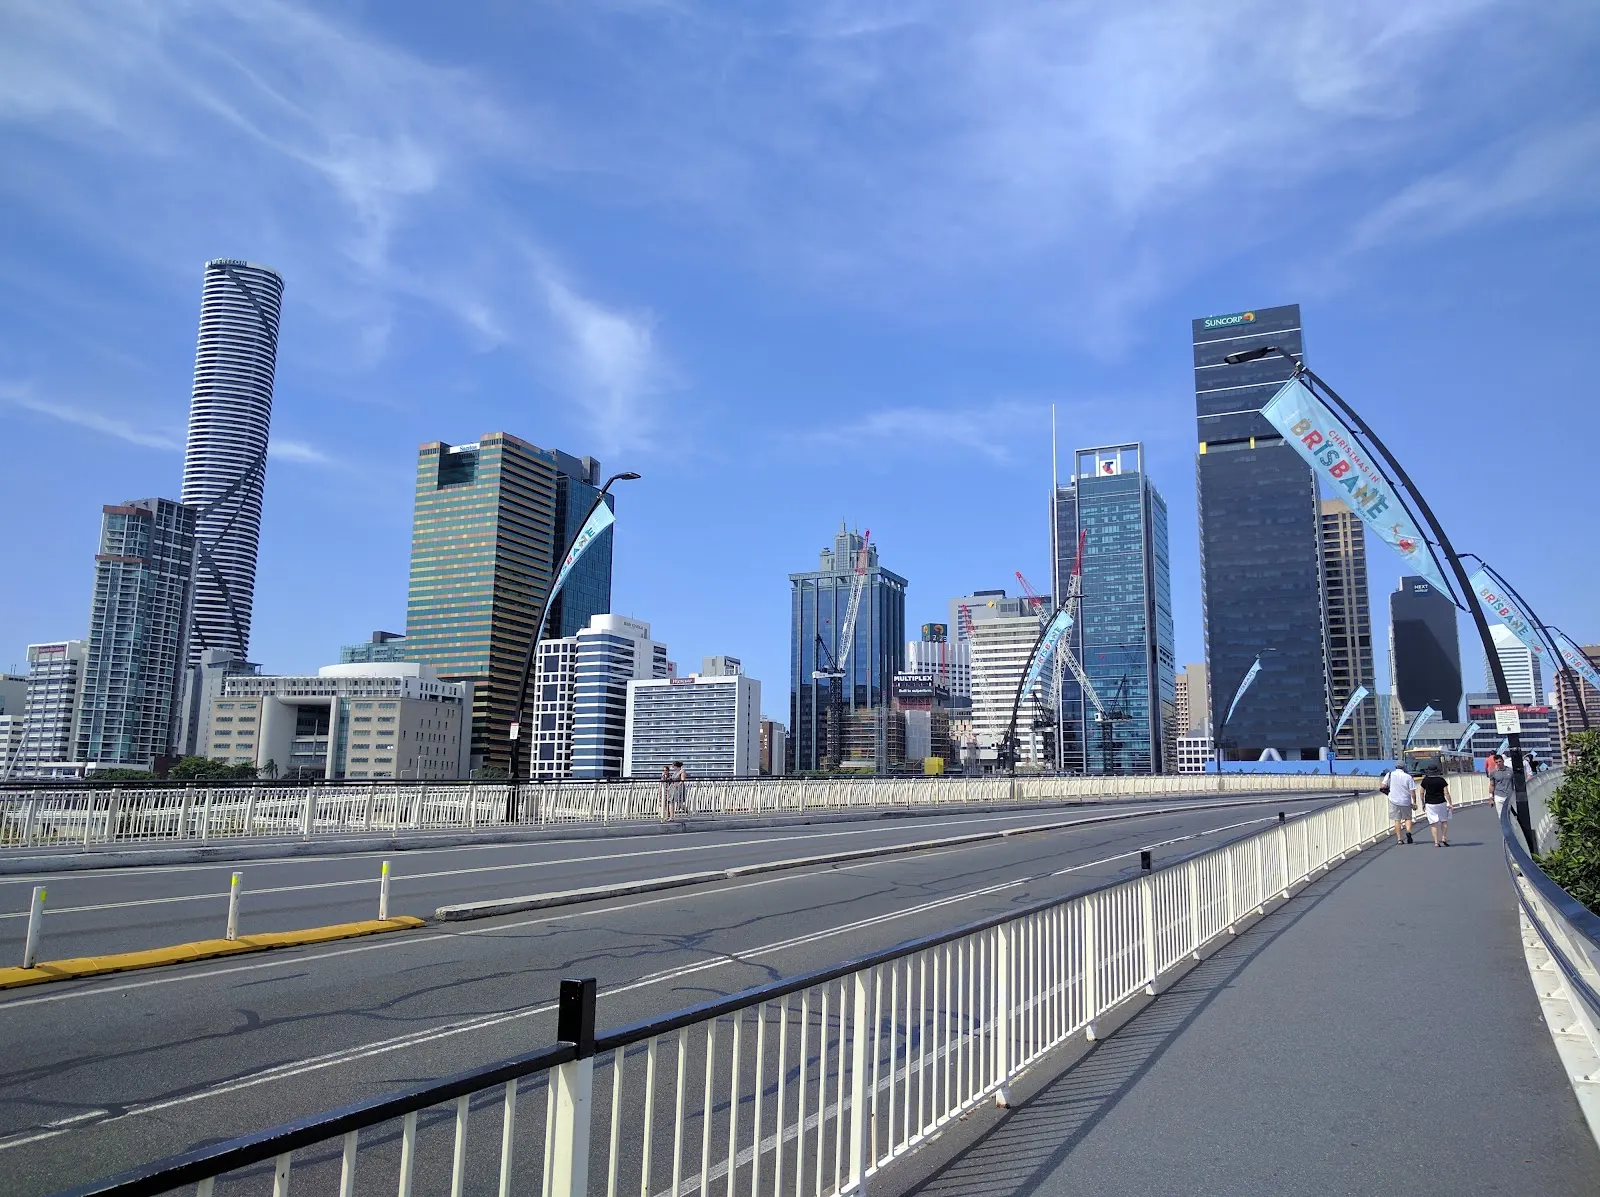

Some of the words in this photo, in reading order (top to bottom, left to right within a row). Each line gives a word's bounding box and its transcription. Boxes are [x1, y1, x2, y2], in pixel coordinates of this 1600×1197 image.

[1205, 316, 1242, 328] SUNCORP
[1290, 418, 1390, 520] BRISBANE
[1328, 430, 1370, 473] CHRISTMAS
[1368, 472, 1381, 483] IN
[1480, 588, 1529, 636] BRISBANE
